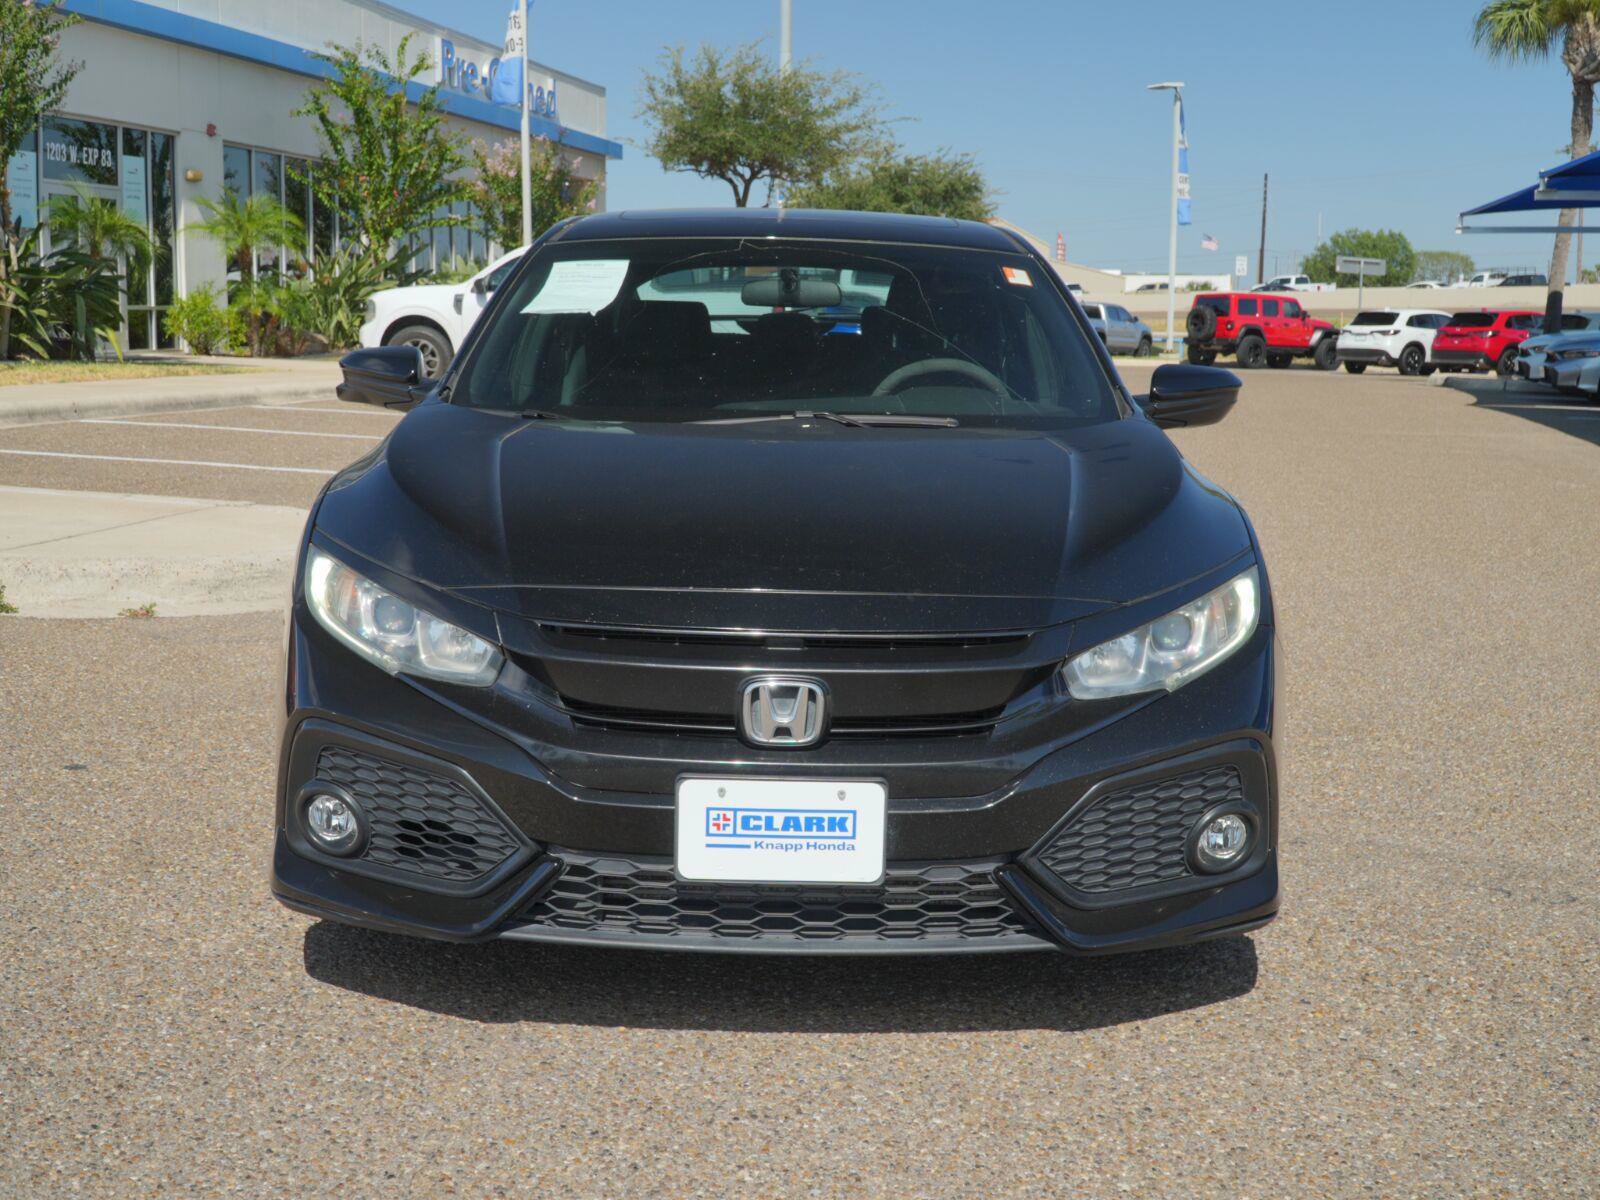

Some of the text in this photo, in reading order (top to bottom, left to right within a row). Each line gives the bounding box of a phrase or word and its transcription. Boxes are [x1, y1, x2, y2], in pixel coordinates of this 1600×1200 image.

[440, 38, 557, 116] Pre-ned
[46, 142, 112, 168] 1203 W. EXP 83
[741, 815, 849, 833] CLARK
[754, 840, 856, 853] Knapp Honda
